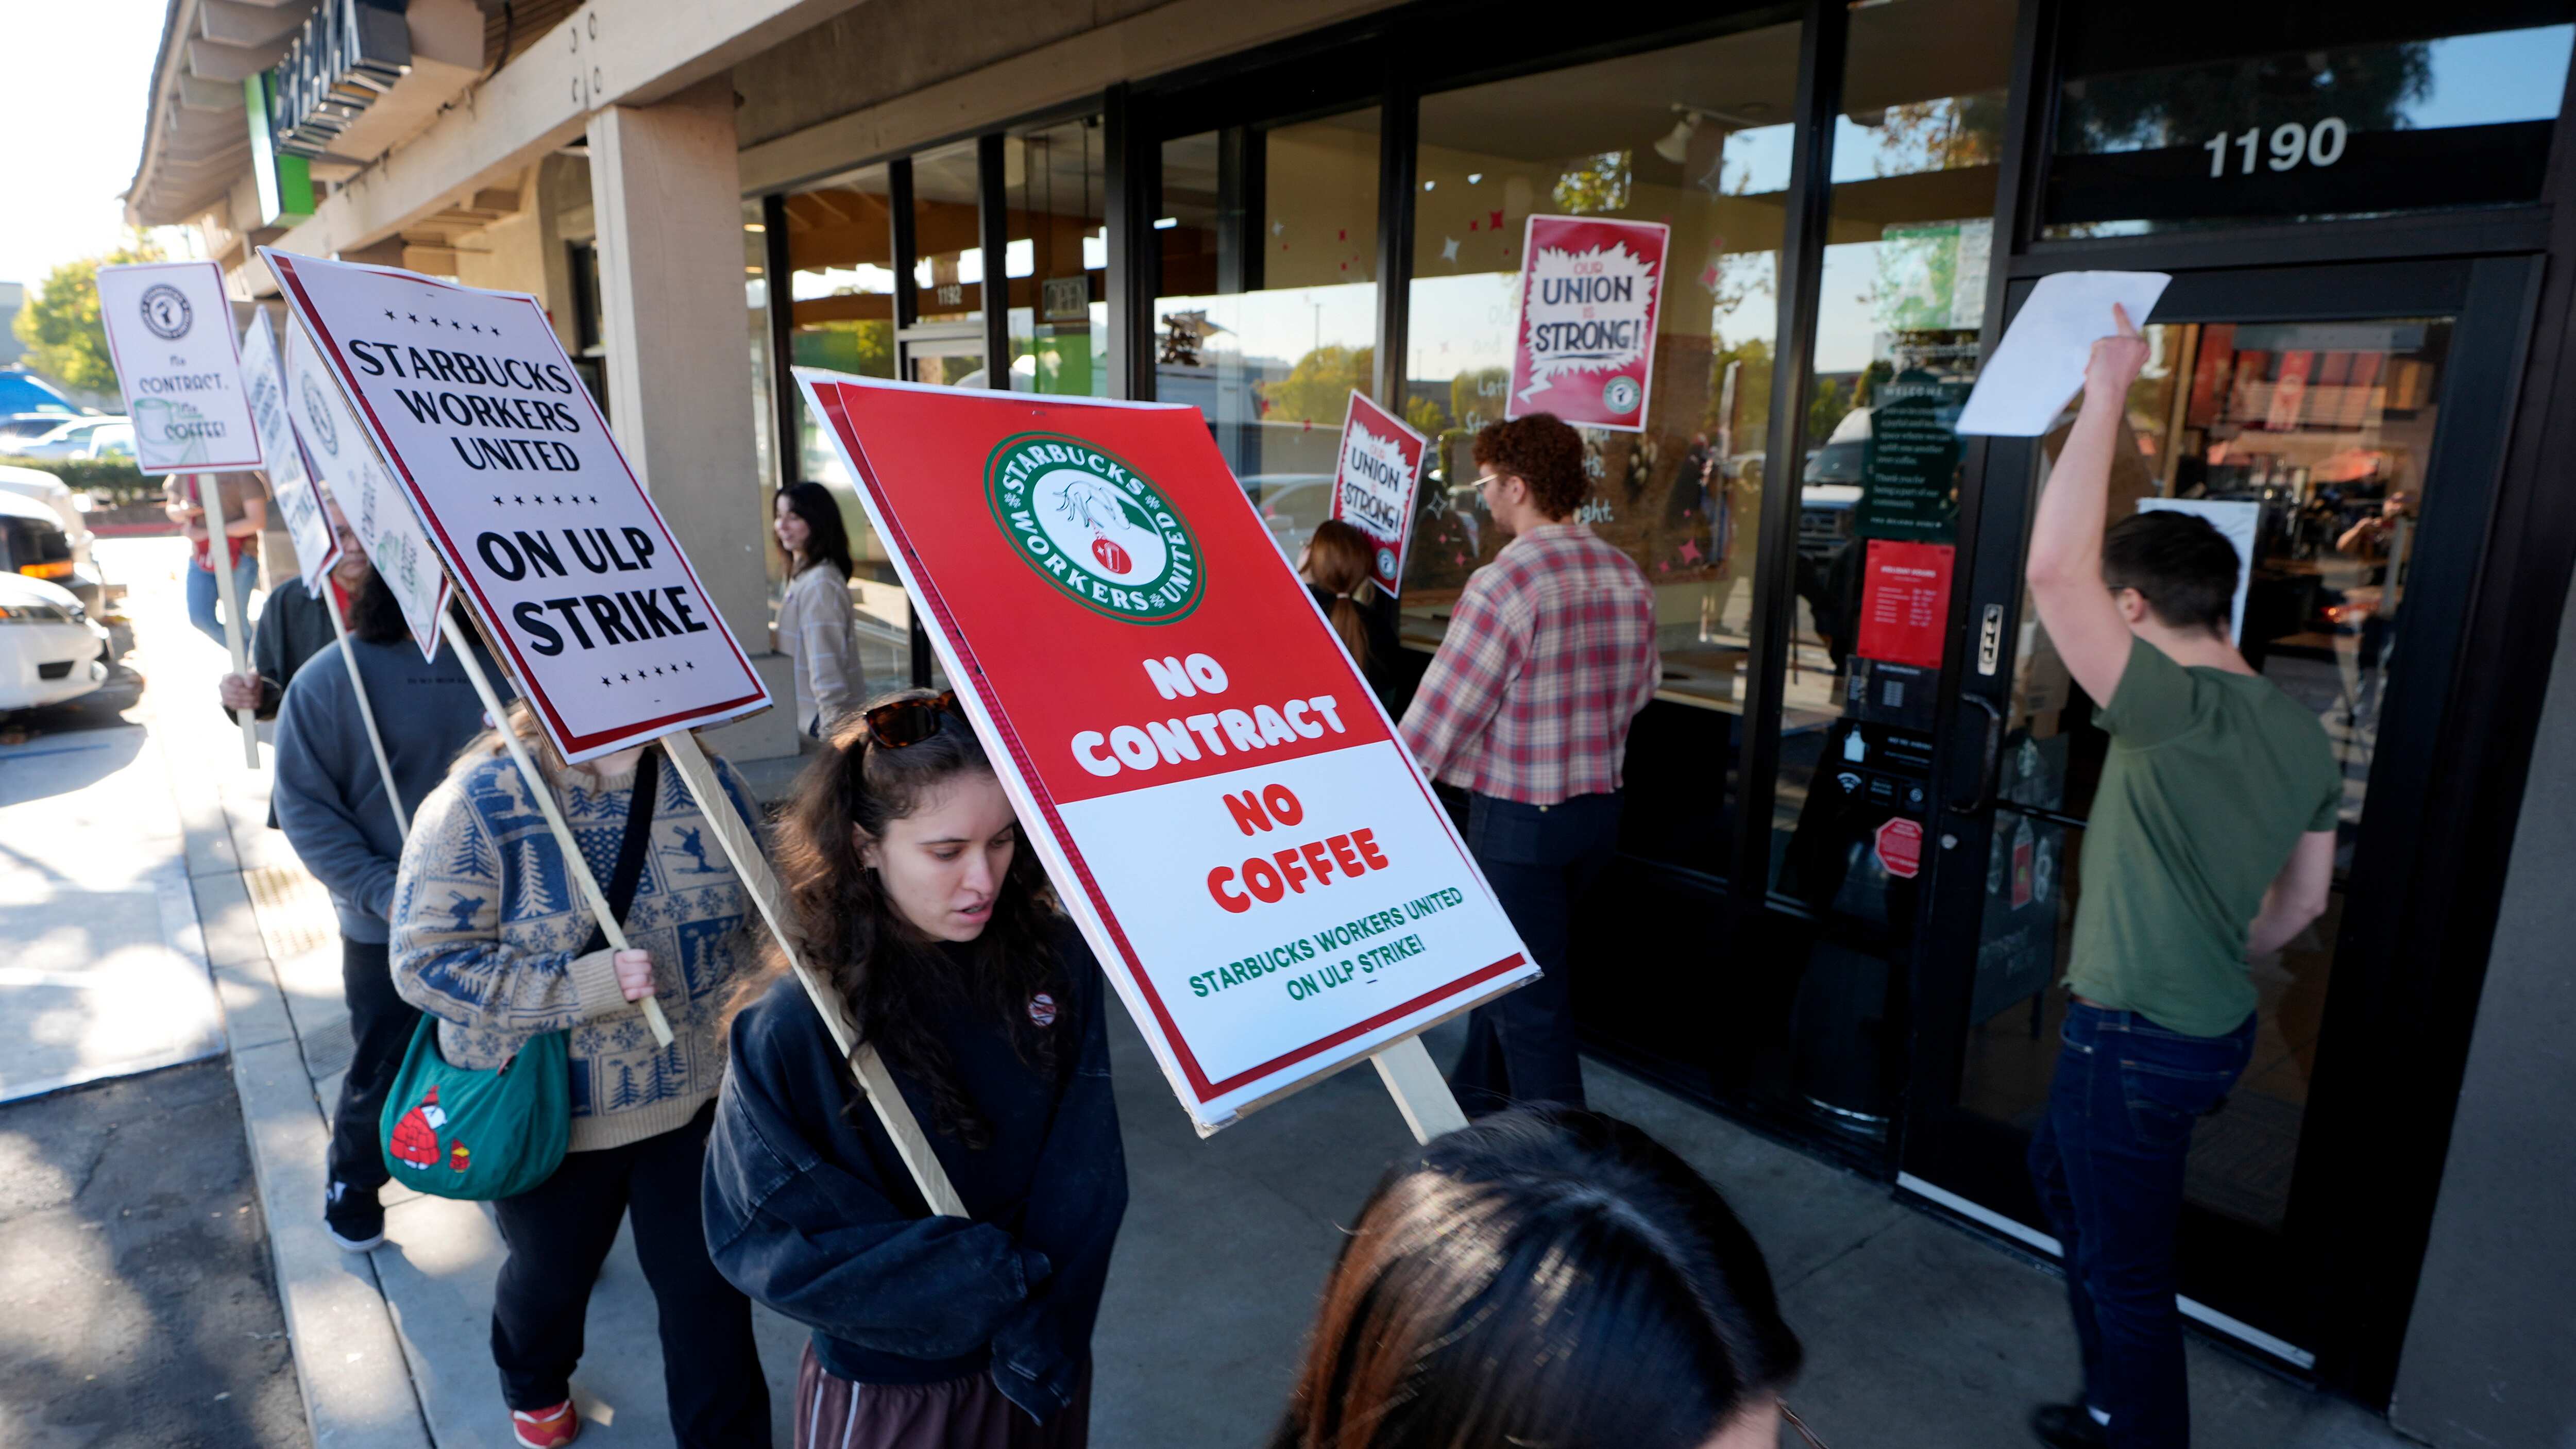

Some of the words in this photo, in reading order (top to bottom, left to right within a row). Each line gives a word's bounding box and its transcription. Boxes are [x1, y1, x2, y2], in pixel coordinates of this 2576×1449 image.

[2204, 117, 2347, 178] 1190
[1543, 276, 1632, 305] UNION
[1574, 262, 1603, 274] OUR
[1535, 319, 1640, 351] STRONG!
[348, 340, 572, 395] STARBUCKS
[394, 389, 580, 433] WORKERS
[451, 437, 580, 472] UNITED
[1003, 444, 1146, 495] STARBUCKS
[1352, 447, 1400, 492] UNION
[1344, 482, 1400, 533] STRONG!
[476, 531, 568, 582] ON
[563, 527, 655, 574] ULP
[1011, 510, 1149, 611] WORKERS
[1155, 512, 1192, 603] UNITED
[513, 586, 708, 656] STRIKE
[1142, 653, 1228, 700] NO
[1071, 695, 1346, 777] CONTRACT
[1223, 784, 1303, 836] NO
[1207, 828, 1388, 913] COFFEE
[1190, 939, 1315, 998] STARBUCKS
[1314, 907, 1405, 952] WORKERS
[1404, 887, 1463, 920] UNITED
[1286, 975, 1320, 1001] ON
[1319, 959, 1355, 989] ULP
[1360, 934, 1425, 973] STRIKE!
